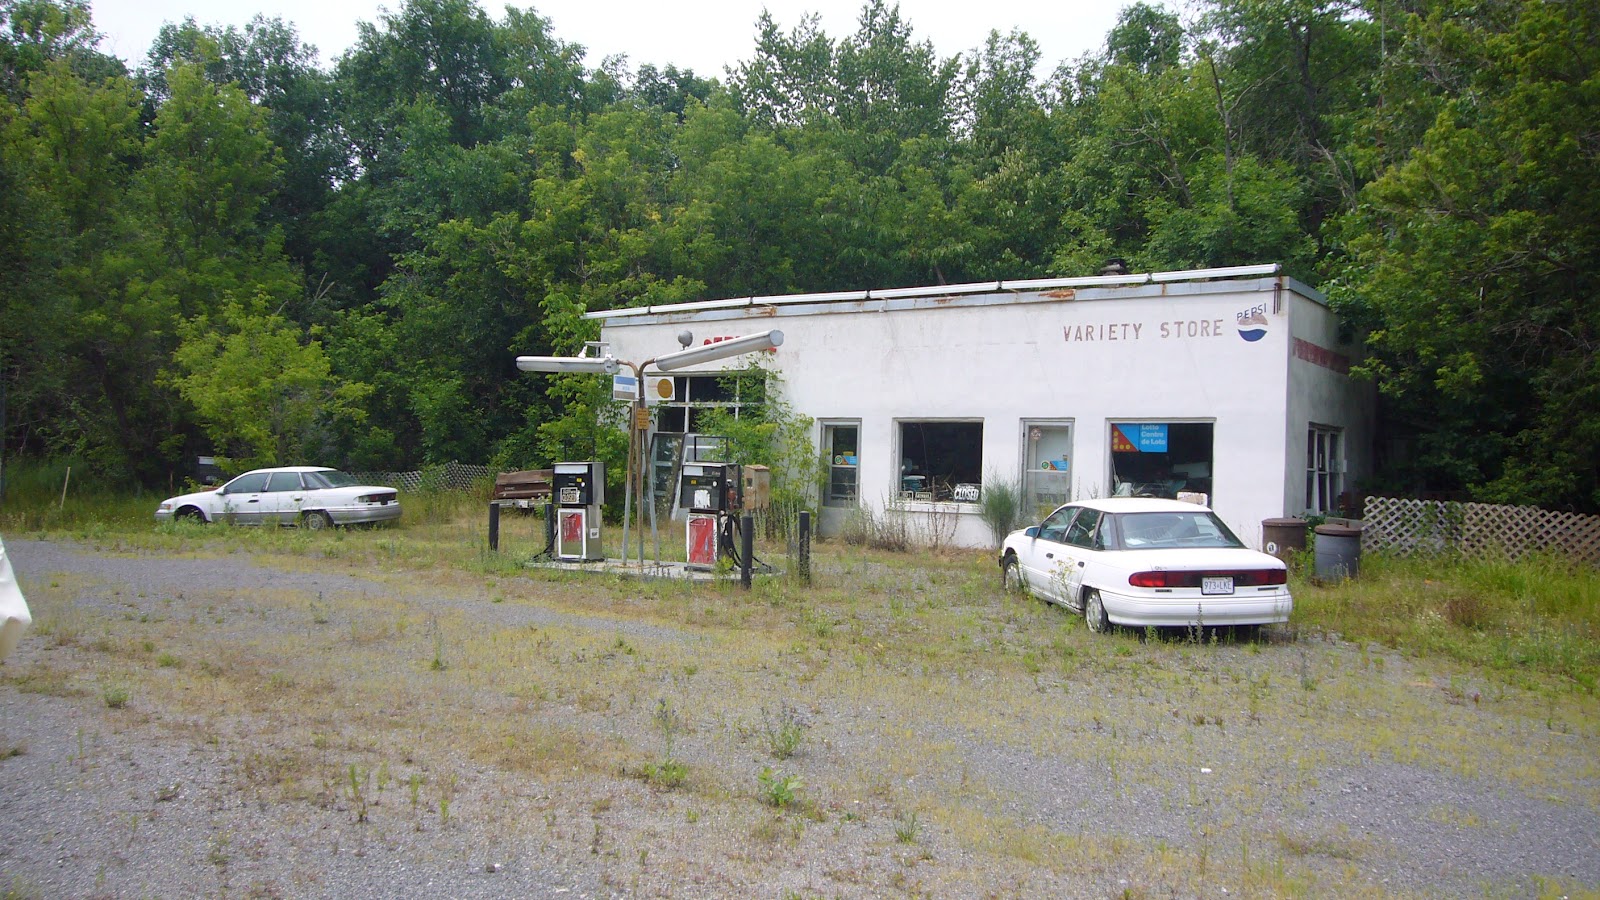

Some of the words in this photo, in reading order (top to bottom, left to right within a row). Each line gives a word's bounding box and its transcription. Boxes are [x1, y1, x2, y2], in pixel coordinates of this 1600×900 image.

[1236, 303, 1267, 321] PEPSI
[1063, 322, 1143, 342] VARIETY
[1160, 319, 1223, 338] STORE
[954, 488, 979, 501] CLOSED
[1204, 581, 1217, 590] 973
